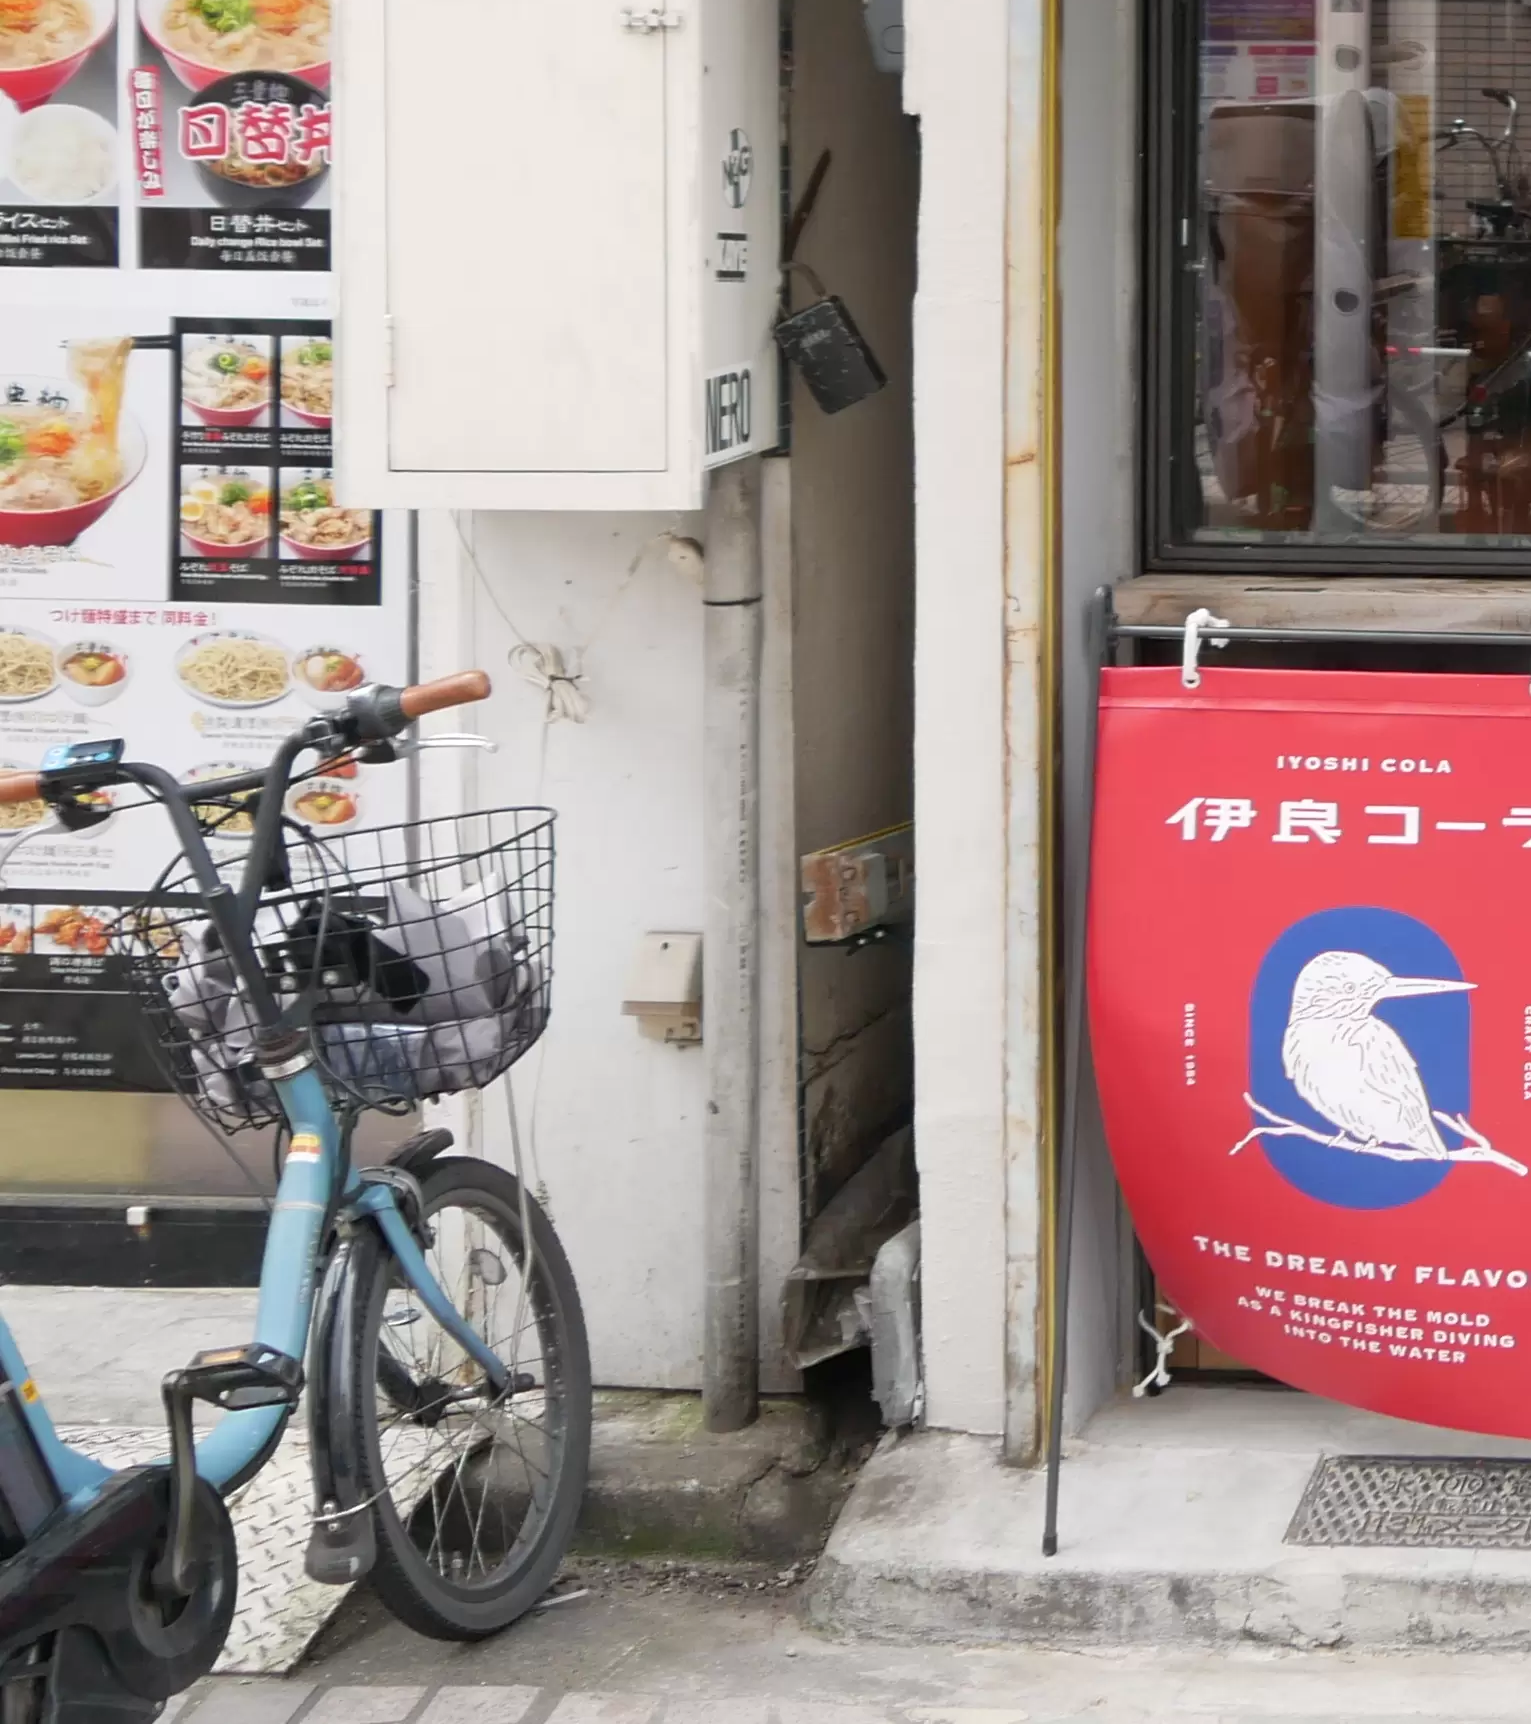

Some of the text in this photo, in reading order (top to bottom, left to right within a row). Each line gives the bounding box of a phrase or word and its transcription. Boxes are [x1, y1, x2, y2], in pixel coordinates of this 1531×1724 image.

[1276, 755, 1452, 774] IYOSHI COLA
[1184, 1003, 1195, 1047] SINCE
[1193, 1235, 1251, 1262] THE
[1265, 1249, 1398, 1282] DREAMY
[1238, 1295, 1516, 1349] AS A KINGFISHER DIVING
[1255, 1285, 1490, 1328] WE BREAK THE MOLD
[1284, 1323, 1467, 1364] INTO THE WATER
